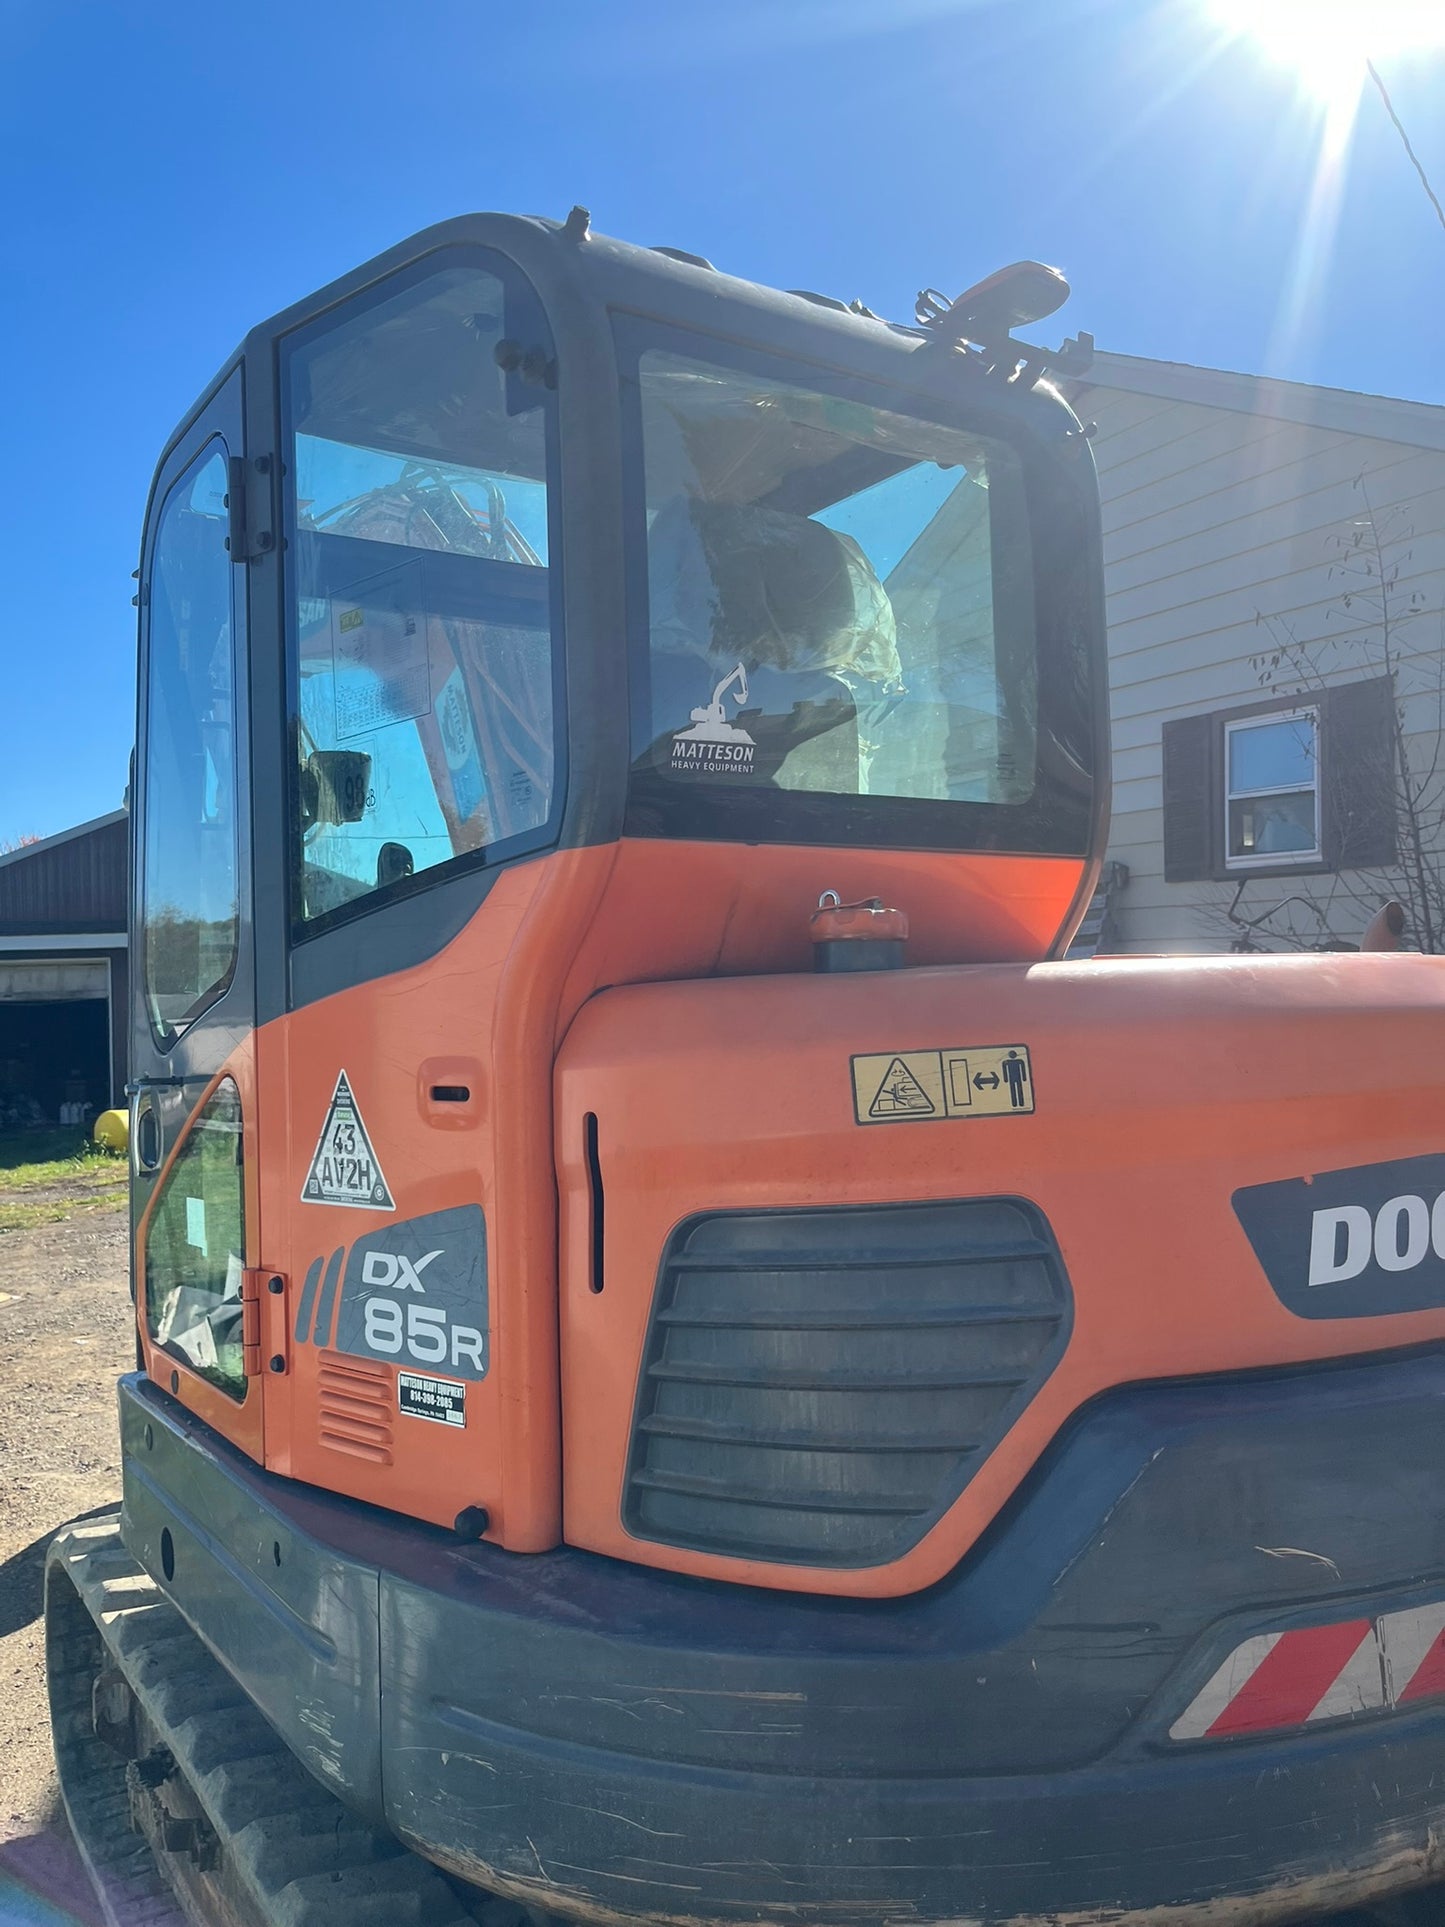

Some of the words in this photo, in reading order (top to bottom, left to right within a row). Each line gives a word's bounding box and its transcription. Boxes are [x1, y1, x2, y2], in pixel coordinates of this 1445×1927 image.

[671, 760, 700, 770] HEAVY
[703, 762, 754, 773] EQUIPMENT
[672, 742, 754, 761] MATTESON
[333, 1123, 355, 1155] 43
[322, 1156, 371, 1191] AV2H
[1308, 1190, 1445, 1286] DO
[362, 1250, 445, 1293] DX
[364, 1297, 484, 1371] 85R
[400, 1375, 423, 1390] MATTESON
[423, 1380, 437, 1393] HEAVY
[437, 1383, 463, 1399] EQUIPMENT
